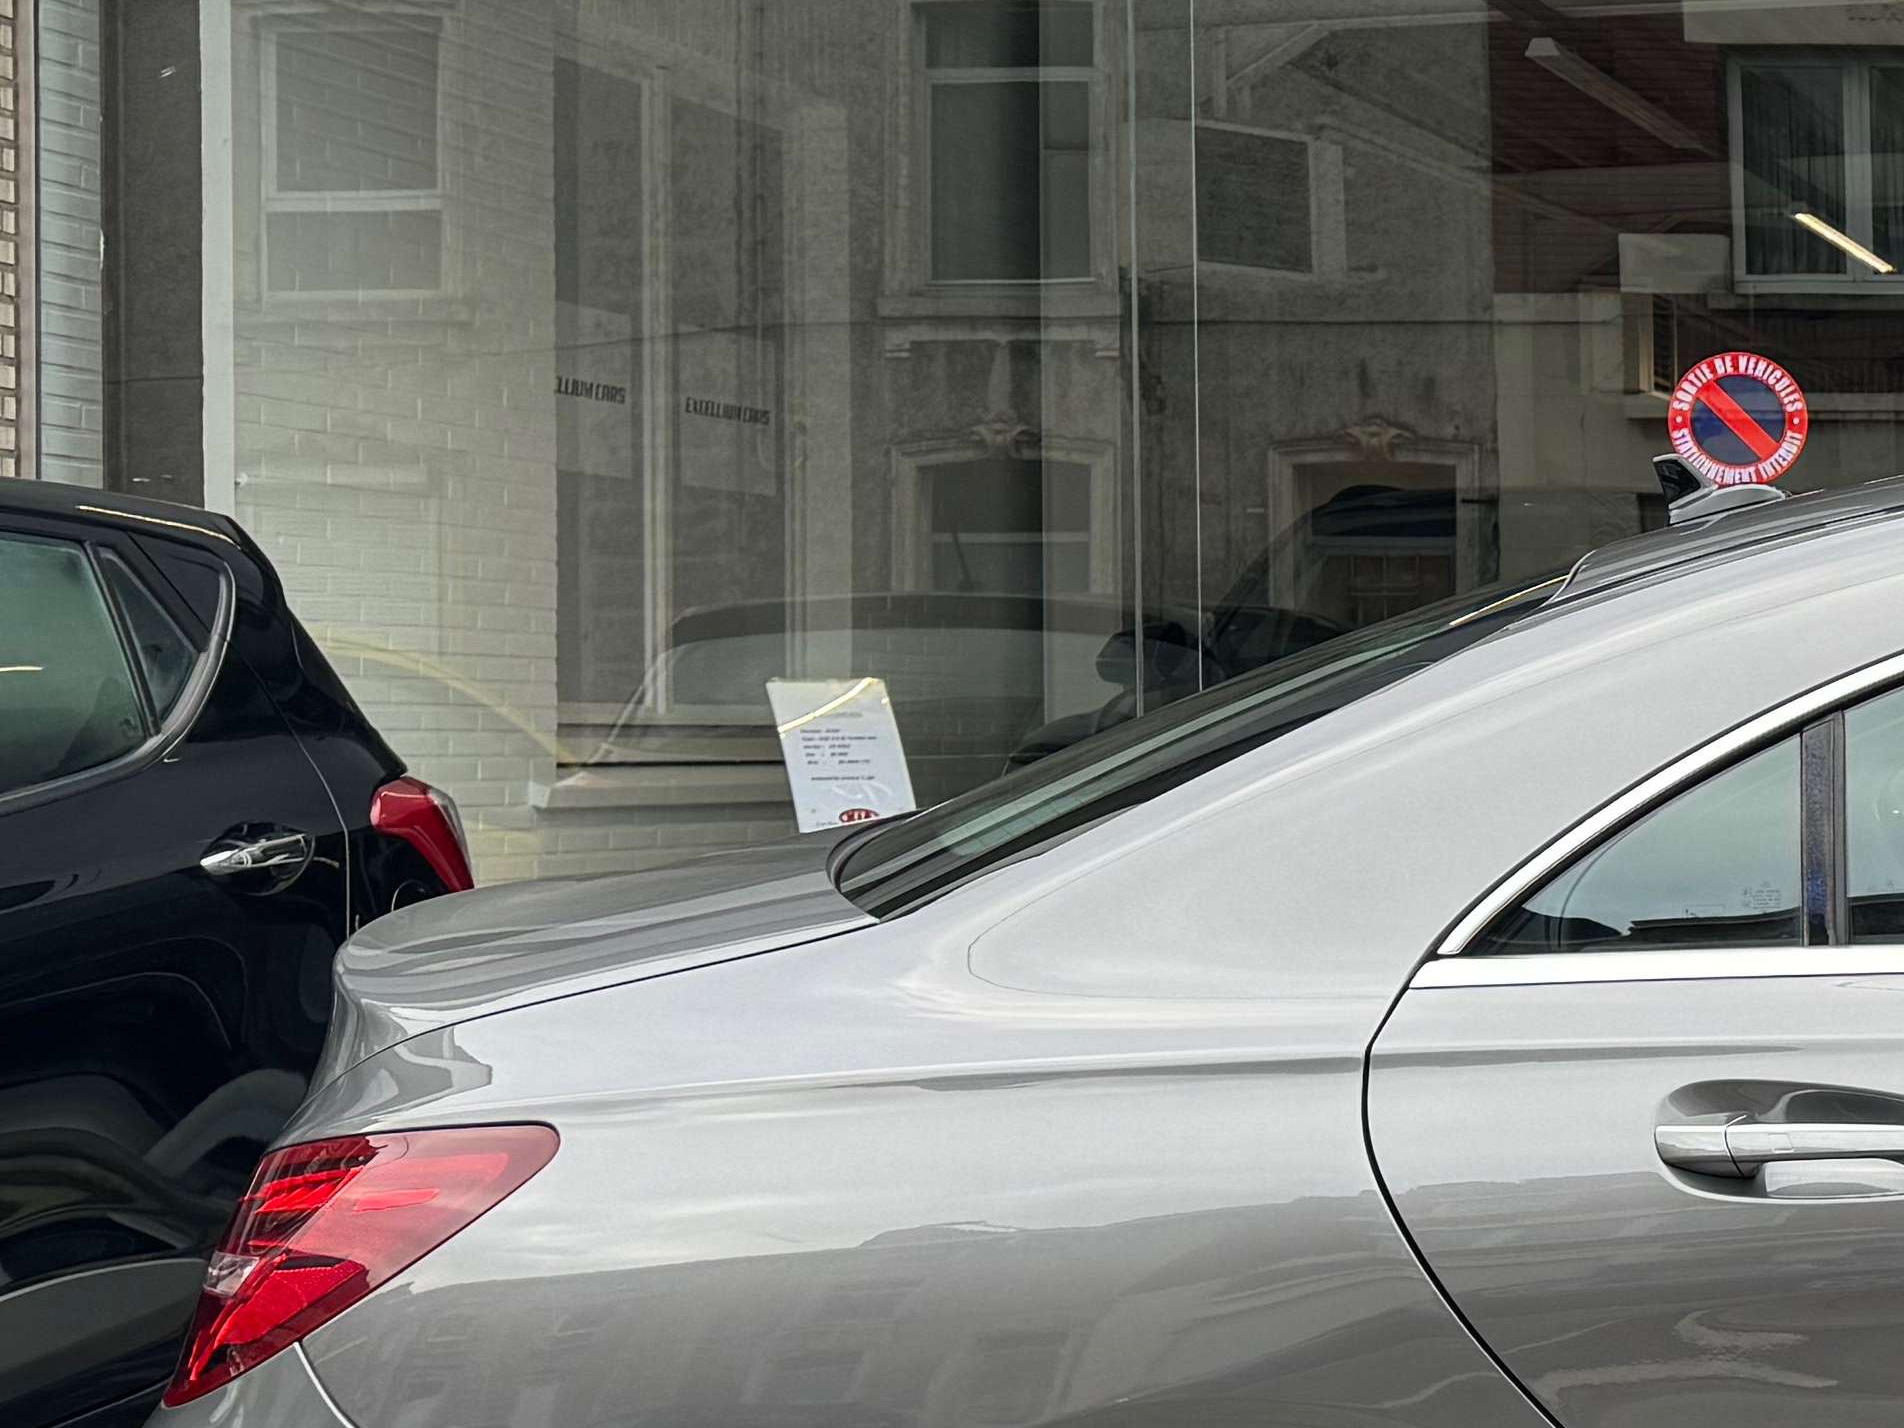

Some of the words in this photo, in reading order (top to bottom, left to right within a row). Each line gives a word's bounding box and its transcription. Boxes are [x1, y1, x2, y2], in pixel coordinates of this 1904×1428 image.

[1672, 362, 1713, 412] SORTIE
[1713, 354, 1735, 372] DE
[1671, 427, 1758, 485] STATIONNEMENT
[1757, 429, 1804, 480] INTERDIT
